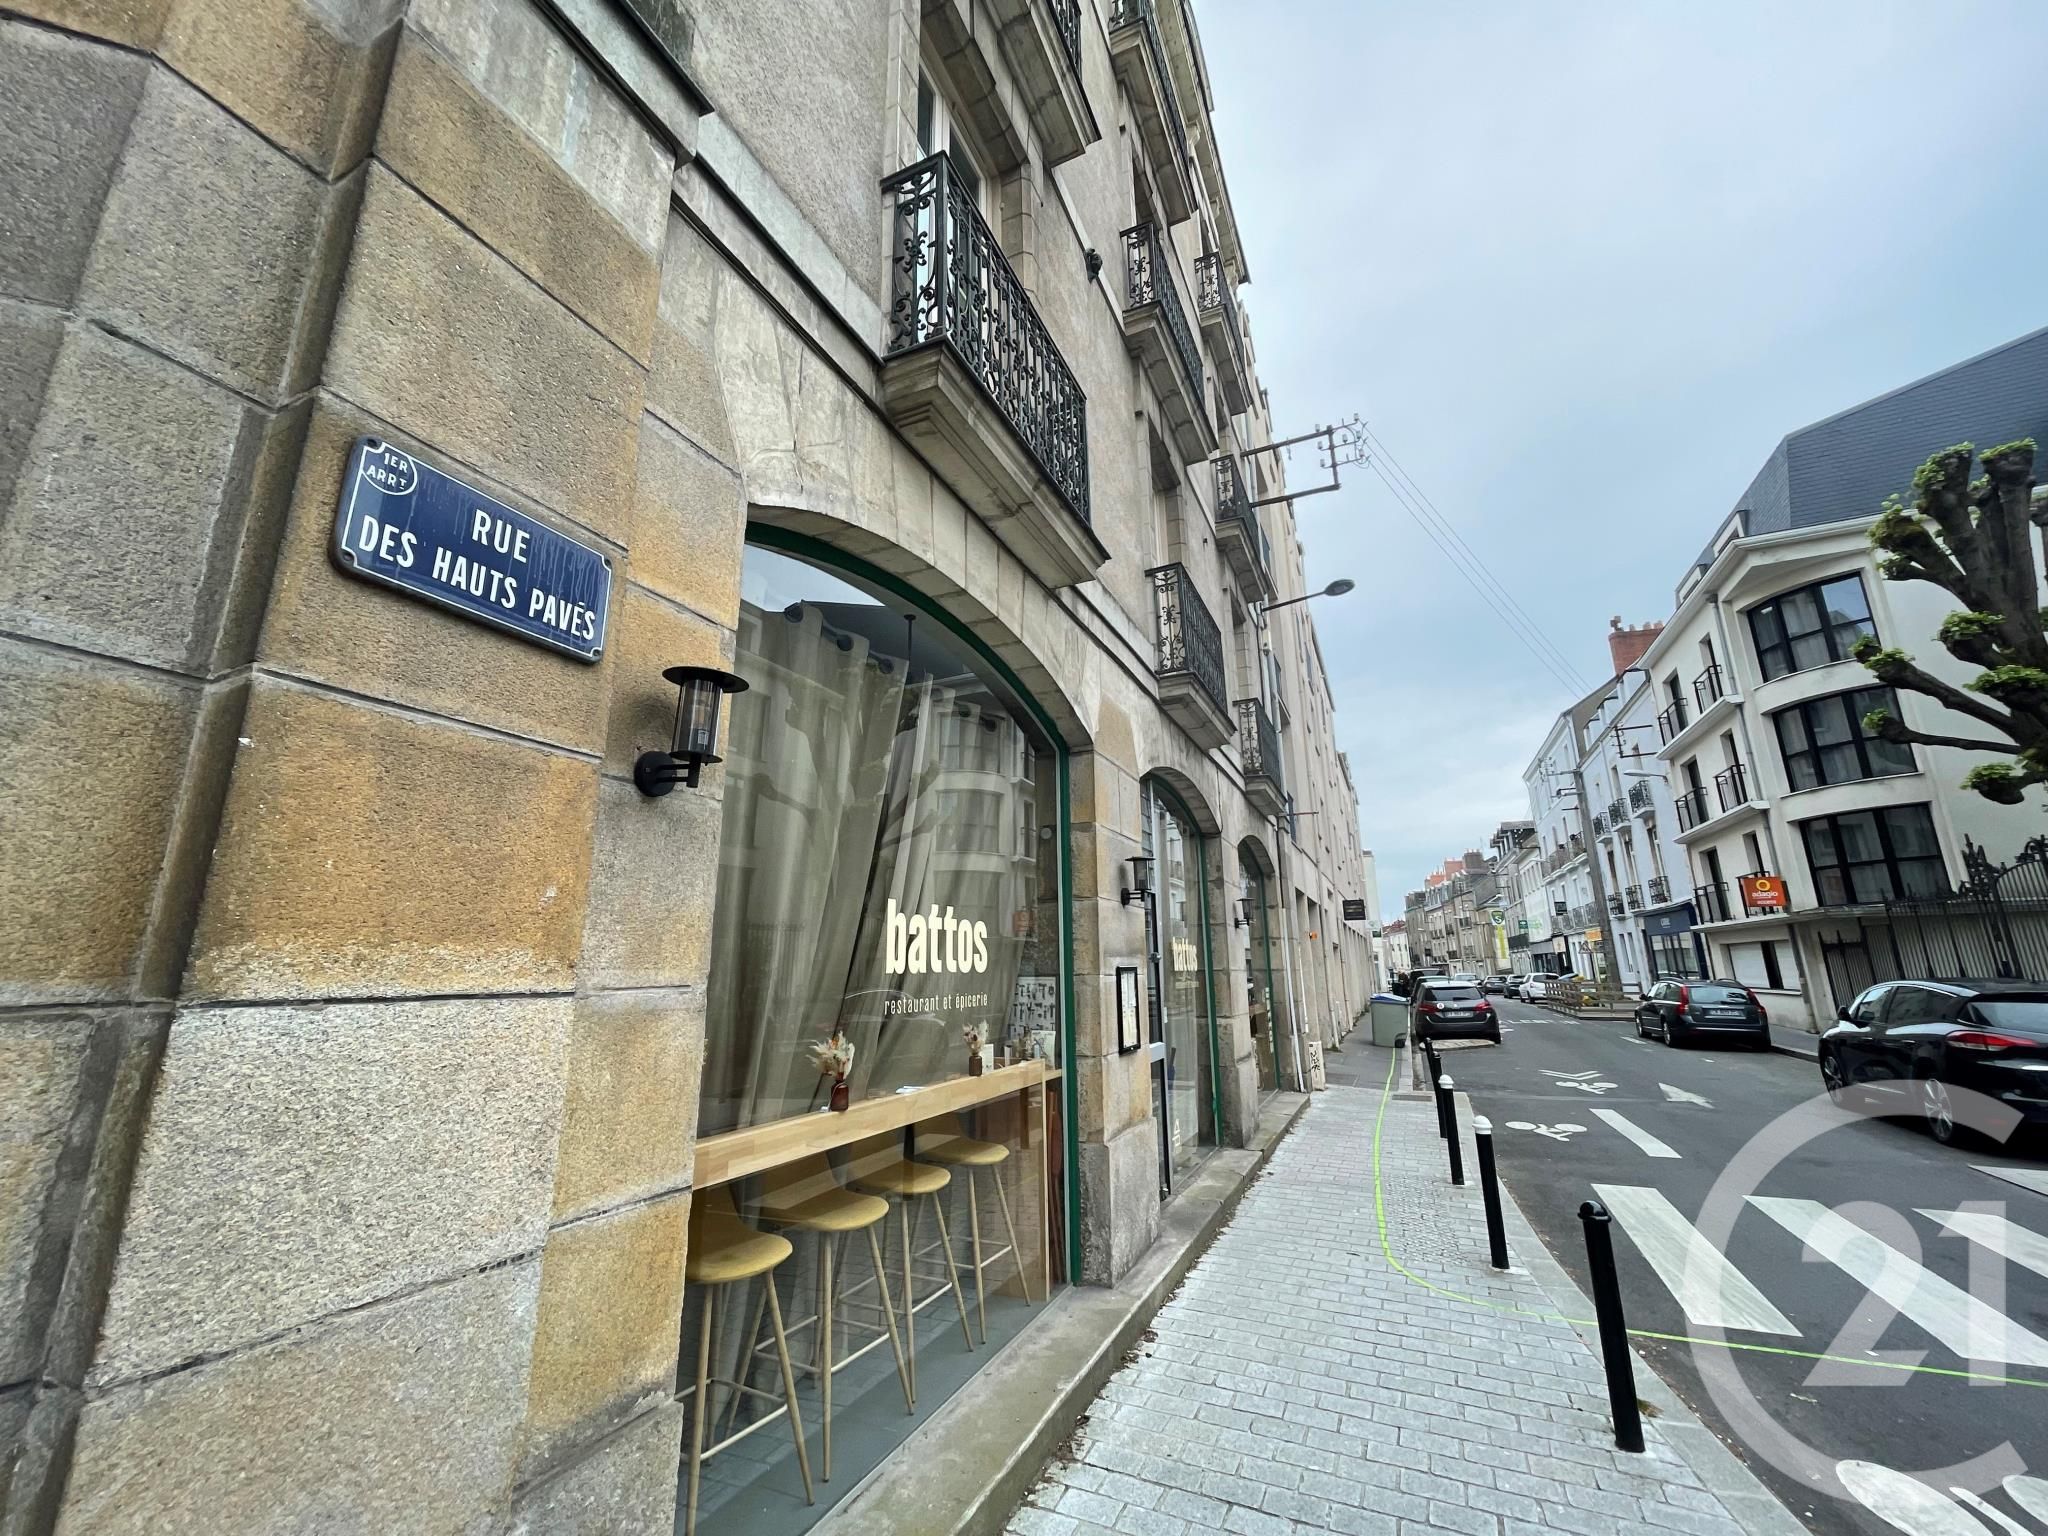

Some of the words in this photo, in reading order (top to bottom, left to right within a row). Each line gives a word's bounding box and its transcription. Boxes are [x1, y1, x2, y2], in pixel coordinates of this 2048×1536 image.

[472, 509, 530, 563] RUE
[359, 514, 418, 568] DES
[431, 546, 518, 609] HAUTS
[528, 587, 596, 641] PAVÉS
[885, 898, 988, 975] battos
[884, 994, 939, 1016] restaurant
[943, 994, 952, 1010] et
[955, 991, 988, 1012] épicerie
